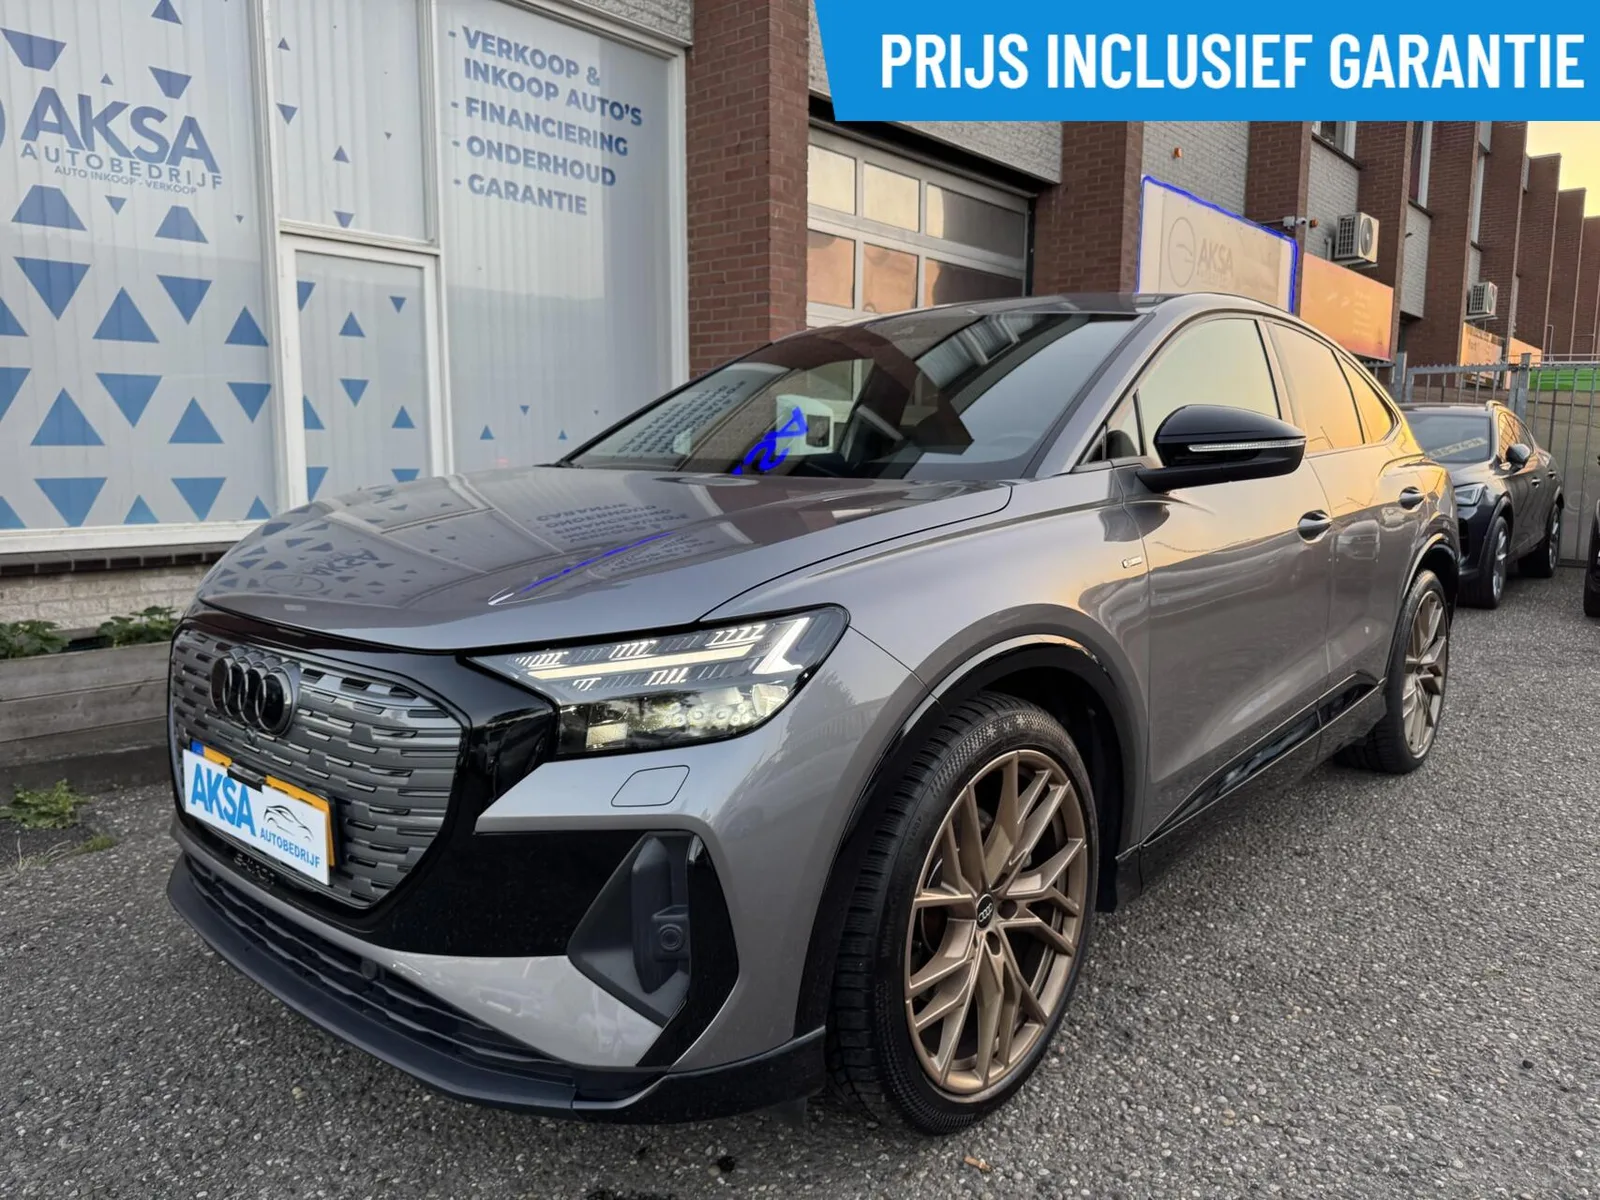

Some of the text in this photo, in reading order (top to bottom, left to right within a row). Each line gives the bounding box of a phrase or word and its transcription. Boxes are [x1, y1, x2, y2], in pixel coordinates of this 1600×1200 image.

[462, 25, 580, 79] VERKOOP
[586, 65, 600, 87] &
[464, 57, 643, 126] INKOOP AUTO'S
[20, 86, 221, 174] AKSA
[465, 96, 629, 157] FINANCIERING
[20, 142, 223, 190] AUTOBEDRIJF
[54, 165, 88, 180] AUTO
[90, 171, 136, 186] INKOOP
[145, 180, 198, 195] VERKOOP
[466, 135, 617, 187] ONDERHOUD
[467, 173, 588, 216] GARANTIE
[1197, 238, 1234, 277] AKSA
[190, 762, 257, 837] AKSA
[259, 827, 321, 869] AUTOBEDRIJF
